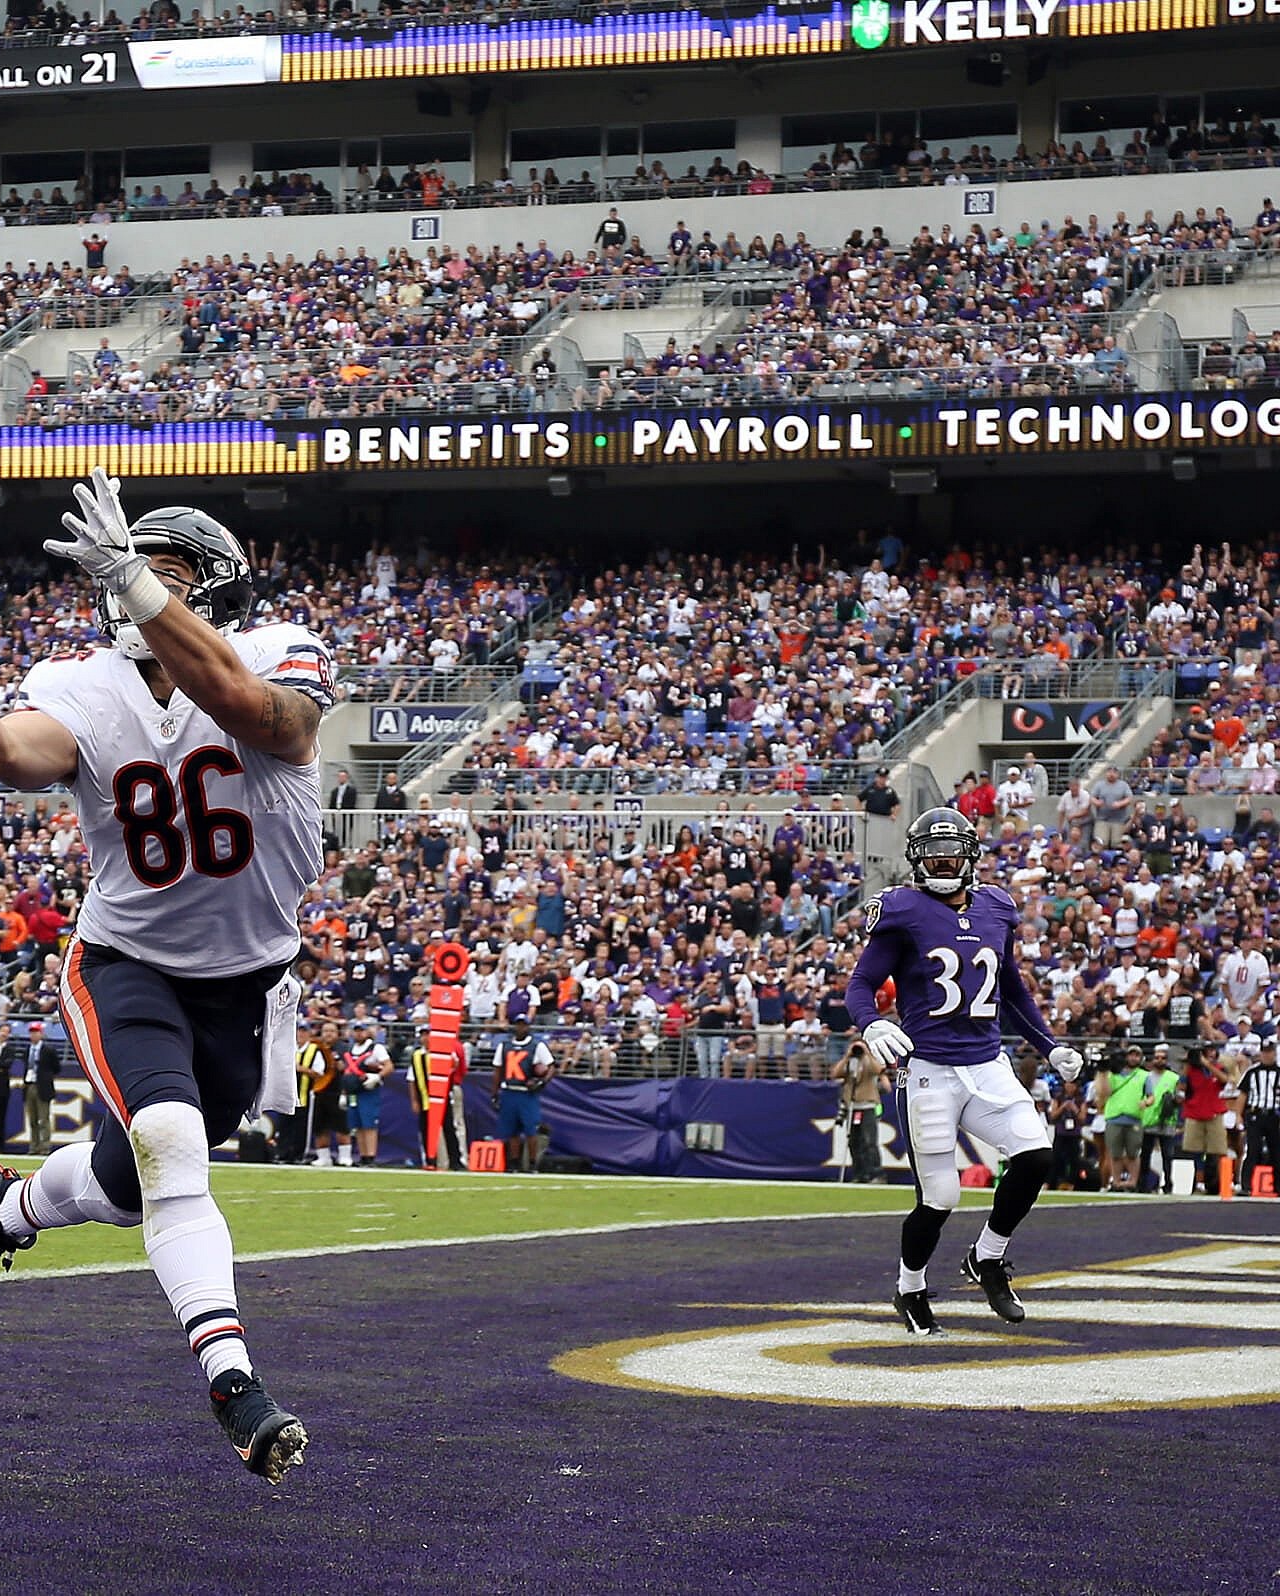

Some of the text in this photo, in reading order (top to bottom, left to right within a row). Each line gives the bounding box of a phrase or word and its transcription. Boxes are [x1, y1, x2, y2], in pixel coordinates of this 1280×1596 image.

[904, 0, 1061, 42] KELLY
[36, 66, 72, 86] ON
[81, 52, 116, 83] 21
[176, 54, 254, 69] Constellation
[324, 422, 570, 463] BENEFITS
[632, 413, 873, 455] PAYROLL
[1124, 640, 1137, 655] 55
[112, 745, 254, 888] 86
[1150, 825, 1166, 842] 34
[483, 836, 500, 854] 34
[1184, 840, 1200, 859] 34
[729, 852, 746, 868] 94
[688, 905, 708, 924] 34
[574, 924, 591, 942] 34
[805, 966, 826, 988] 54
[926, 945, 1000, 1019] 32
[1236, 966, 1249, 984] 10
[505, 1050, 529, 1081] K
[476, 1146, 497, 1169] 10
